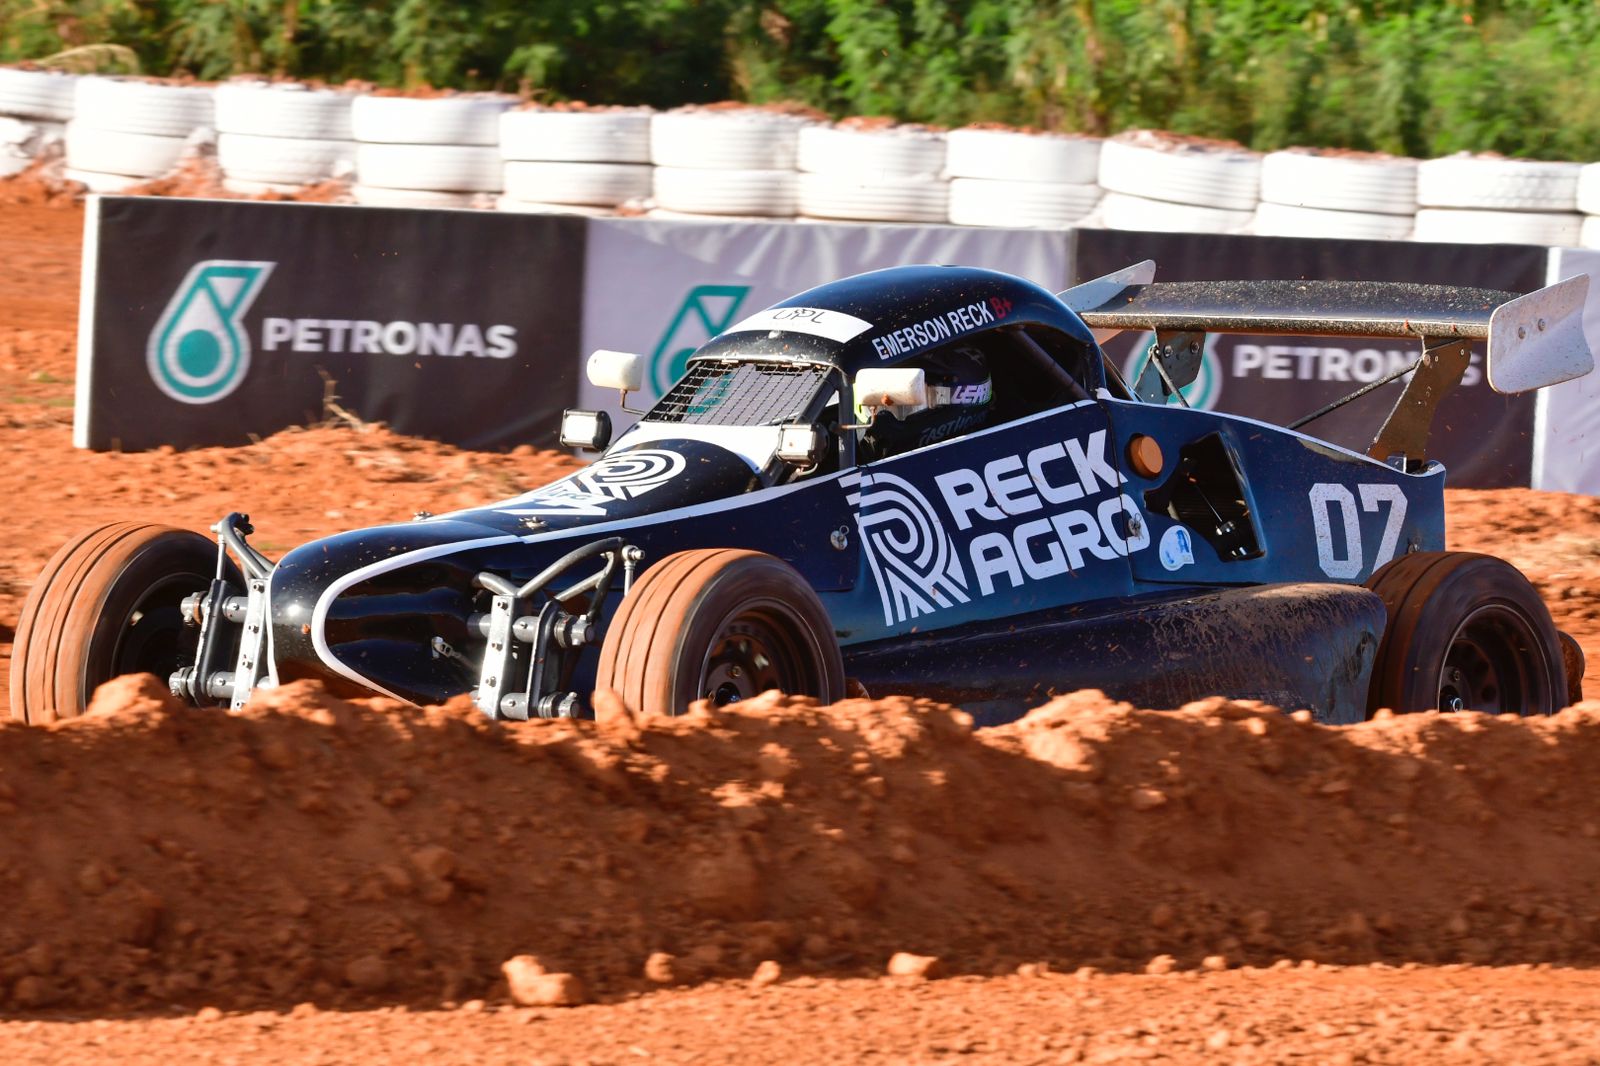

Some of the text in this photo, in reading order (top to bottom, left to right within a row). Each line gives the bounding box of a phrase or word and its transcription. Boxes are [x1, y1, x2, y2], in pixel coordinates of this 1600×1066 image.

[261, 317, 518, 358] PETRONAS
[872, 316, 951, 360] EMERSON
[947, 300, 994, 334] RECK
[1232, 344, 1482, 386] PETRONS
[935, 429, 1128, 531] RECK
[969, 494, 1150, 596] AGRO
[1308, 482, 1408, 578] 07
